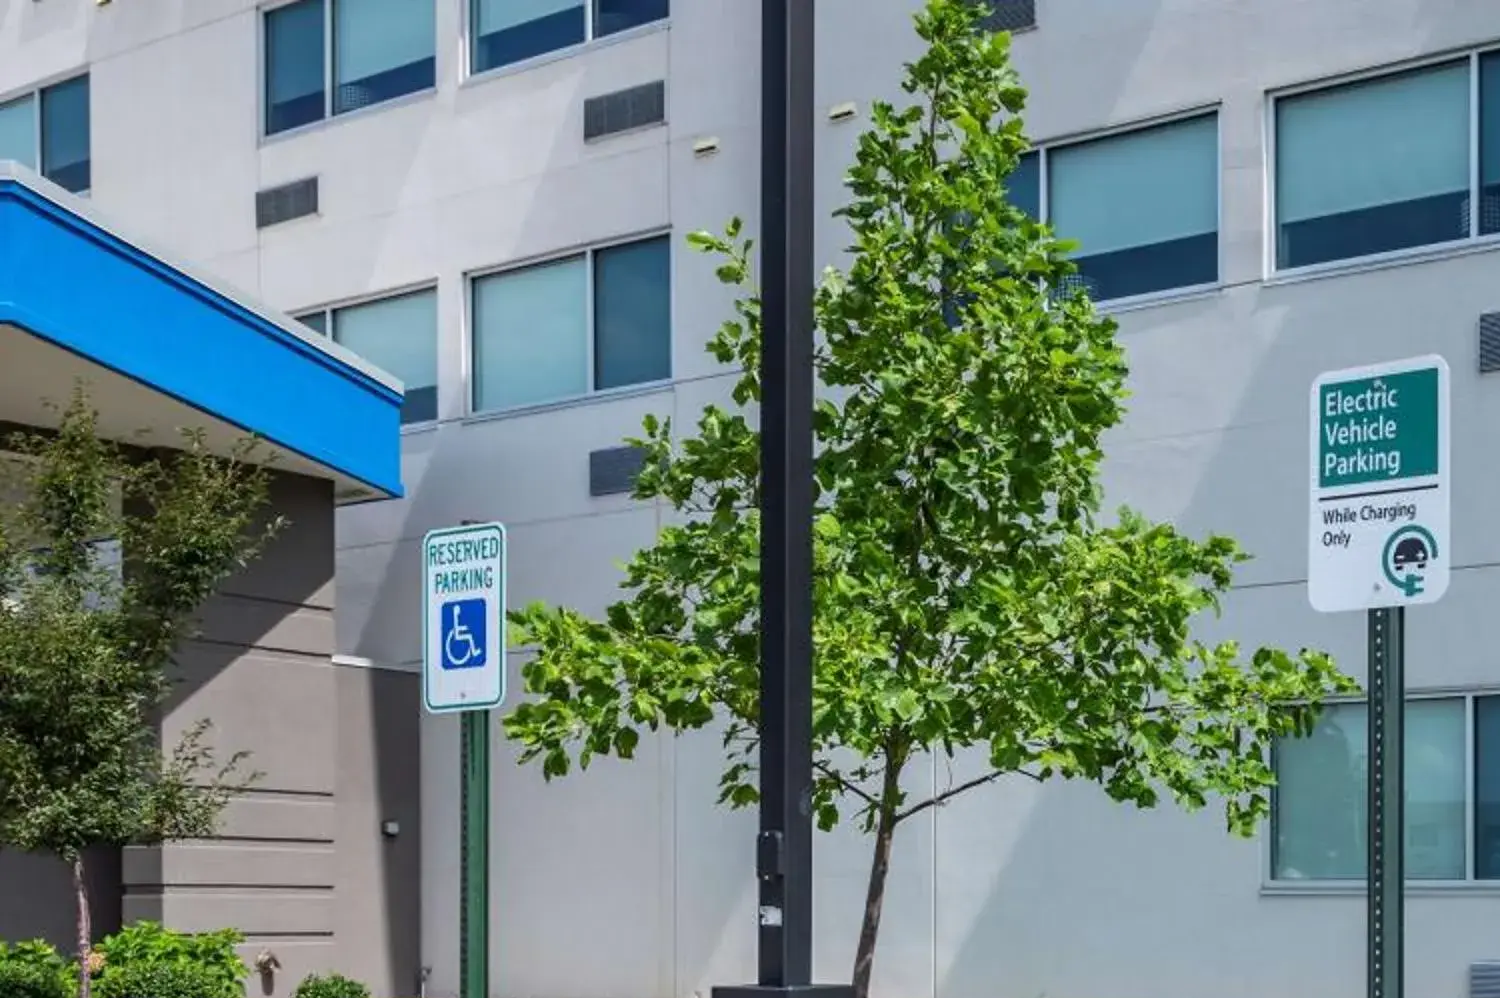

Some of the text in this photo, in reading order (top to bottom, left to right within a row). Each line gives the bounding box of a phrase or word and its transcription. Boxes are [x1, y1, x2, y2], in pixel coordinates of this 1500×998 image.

[1325, 384, 1398, 416] Electric
[1325, 415, 1397, 446] Vehicle
[1325, 449, 1401, 476] Parking
[1323, 503, 1417, 525] While Charging
[429, 537, 499, 566] RESERVED
[1323, 531, 1351, 549] Only
[435, 567, 493, 593] PARKING
